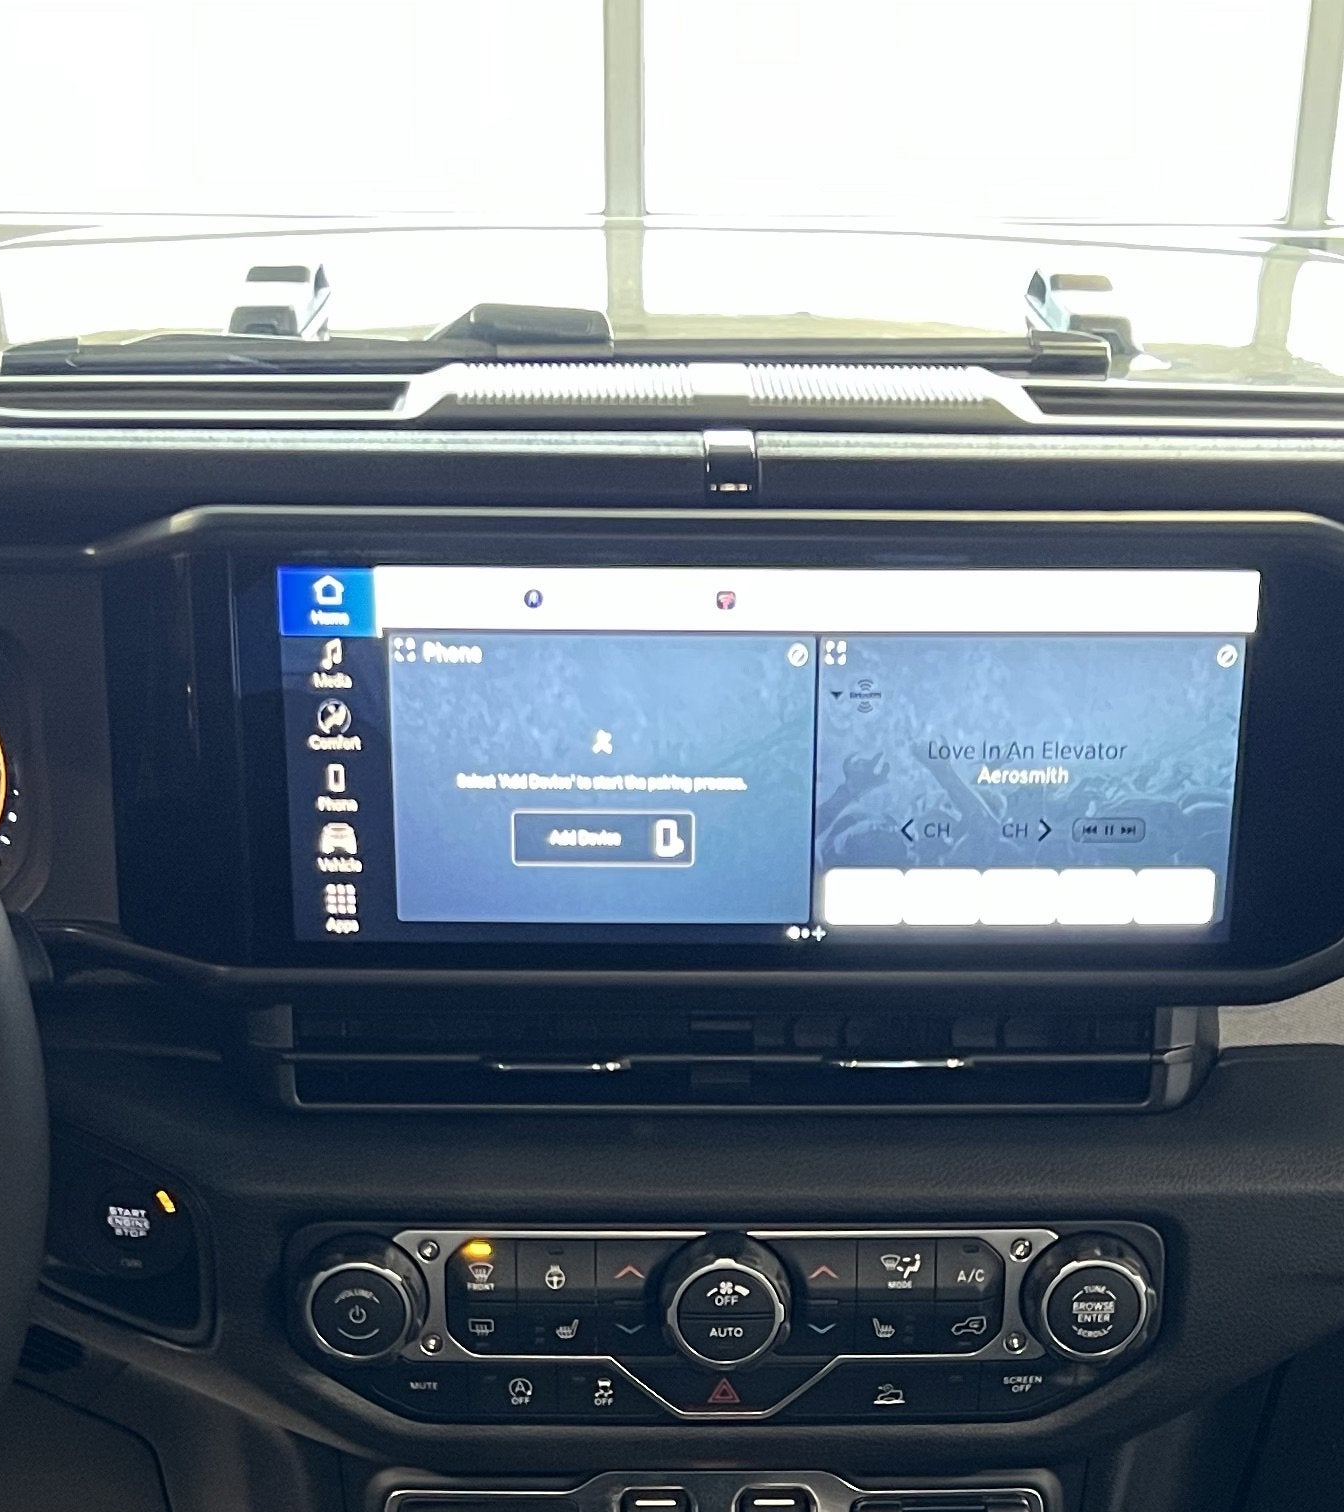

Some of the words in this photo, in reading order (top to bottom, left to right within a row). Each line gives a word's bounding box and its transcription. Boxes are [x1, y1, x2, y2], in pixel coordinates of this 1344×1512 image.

[422, 641, 483, 664] Phone
[927, 740, 976, 761] Love
[982, 740, 1001, 760] In
[1007, 740, 1035, 760] An
[1042, 740, 1128, 761] Elevator
[977, 765, 1070, 785] Aerosmith
[923, 822, 951, 838] CH
[1001, 822, 1029, 838] CH
[956, 1269, 985, 1283] A/C
[887, 1280, 913, 1289] MODE
[1082, 1285, 1107, 1294] TUNE
[714, 1295, 739, 1307] OFF
[1072, 1300, 1115, 1311] BROWSE
[1077, 1313, 1111, 1323] ENTER
[709, 1327, 744, 1338] AUTO
[1003, 1375, 1043, 1385] SCREEN
[410, 1381, 439, 1391] MUTE
[1011, 1384, 1032, 1393] OFF
[510, 1397, 531, 1406] OFF
[594, 1397, 614, 1407] OFF
